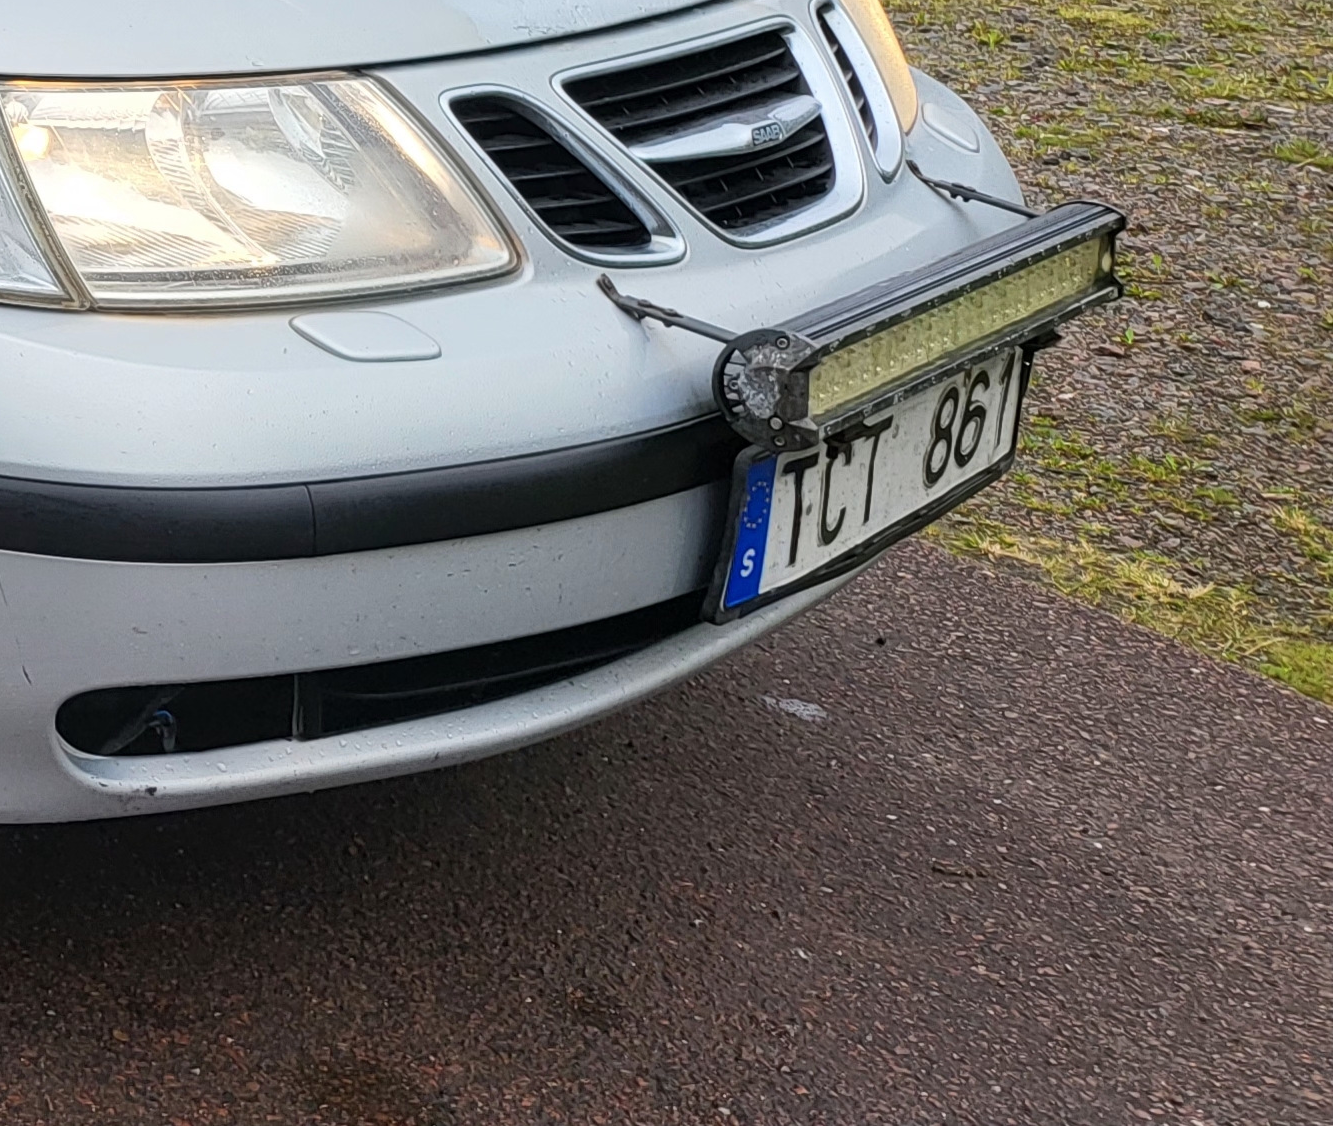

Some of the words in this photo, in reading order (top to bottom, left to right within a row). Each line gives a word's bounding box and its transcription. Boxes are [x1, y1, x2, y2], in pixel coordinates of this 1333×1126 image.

[753, 124, 780, 144] SAAB
[783, 414, 894, 569] TCT
[922, 353, 1016, 489] 861
[740, 548, 756, 577] S
